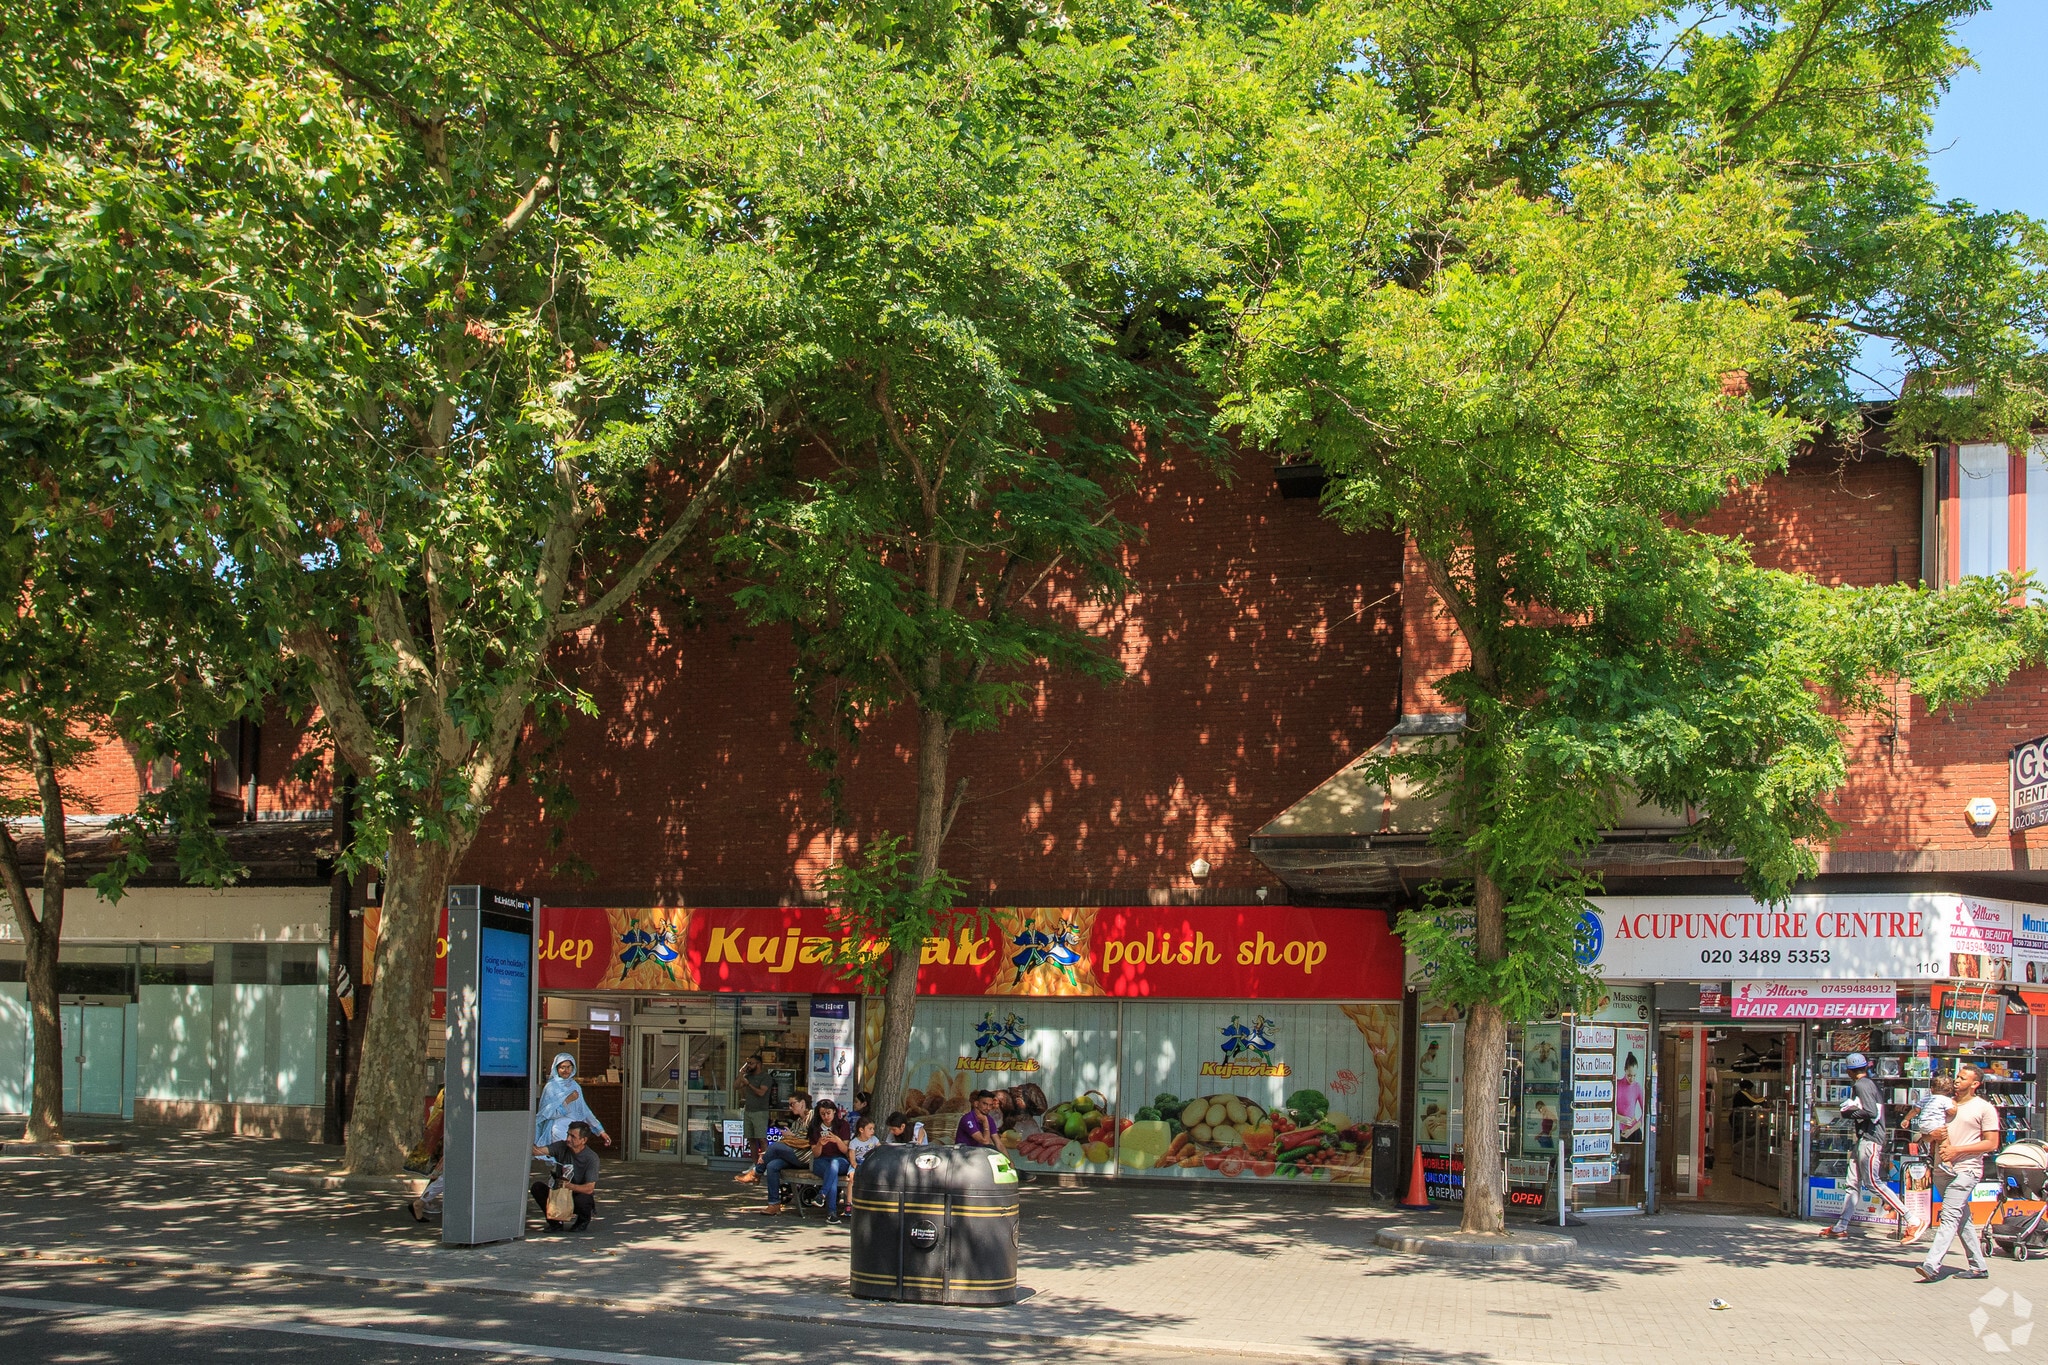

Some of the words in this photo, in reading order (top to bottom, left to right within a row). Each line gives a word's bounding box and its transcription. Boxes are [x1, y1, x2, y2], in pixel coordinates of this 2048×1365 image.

[2018, 785, 2048, 805] RENT
[2015, 812, 2036, 829] 0208
[1973, 905, 2001, 921] Allure
[1614, 912, 1808, 939] ACUPUNCTURE
[1815, 912, 1924, 939] CENTRE
[1951, 926, 1968, 937] HAIR
[1968, 928, 1983, 938] AND
[1984, 929, 2012, 941] BEAUTY
[704, 926, 998, 974] Kujawak
[1102, 931, 1222, 974] polish
[1236, 931, 1327, 974] shop
[485, 956, 499, 967] Going
[1701, 950, 1732, 964] 020
[1738, 950, 1781, 964] 3489
[1787, 950, 1830, 964] 5353
[486, 966, 493, 974] No
[494, 967, 505, 975] fees
[1916, 963, 1940, 973] 110
[1766, 983, 1808, 997] Allure
[1821, 984, 1891, 994] 07459484912
[1613, 992, 1647, 1004] Massage
[1736, 1003, 1779, 1017] HAIR
[1782, 1003, 1819, 1017] AND
[1823, 1003, 1891, 1017] BEAUTY
[1944, 1010, 1994, 1021] UNLOCKNG
[1955, 1022, 1989, 1033] REPAIR
[1577, 1031, 1593, 1043] Pain
[1596, 1031, 1612, 1043] Clinic
[1626, 1034, 1644, 1042] Weight
[956, 1056, 1040, 1073] Kujawiak
[1199, 1061, 1292, 1078] Kujawiak
[1576, 1058, 1592, 1070] Skin
[1595, 1058, 1611, 1070] Clinic
[1576, 1086, 1592, 1098] Hair
[1595, 1086, 1611, 1098] Loss
[967, 1120, 974, 1128] 3
[1576, 1113, 1590, 1123] Sexual
[1445, 1159, 1465, 1171] PHON
[1424, 1172, 1463, 1185] UNLOCKIN
[1428, 1186, 1434, 1197] &
[1436, 1187, 1463, 1200] REPAIR
[1511, 1192, 1542, 1205] OPEN
[1974, 1187, 2001, 1198] Lycamo
